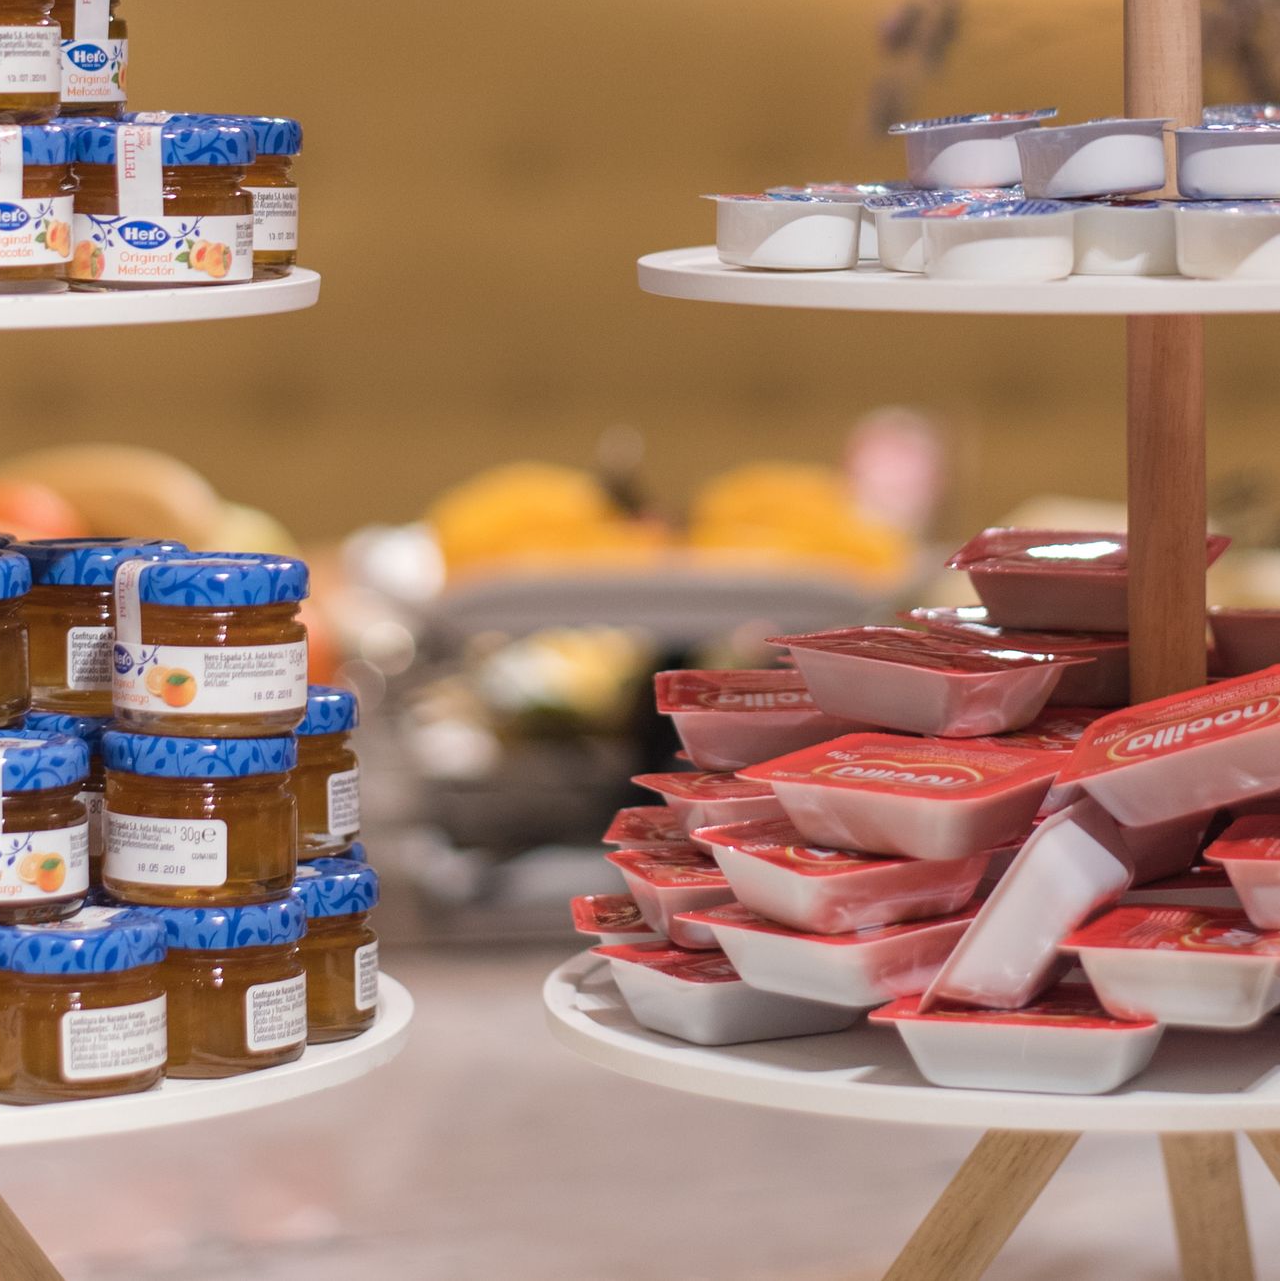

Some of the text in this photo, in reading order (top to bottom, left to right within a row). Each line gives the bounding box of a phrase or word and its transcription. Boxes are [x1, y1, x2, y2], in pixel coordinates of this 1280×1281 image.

[74, 51, 106, 63] Hero
[69, 73, 110, 84] Original
[67, 85, 111, 96] Melocotón
[125, 138, 136, 179] PETIT
[124, 227, 166, 241] Hero
[120, 251, 173, 265] Original
[118, 264, 175, 276] Melocotón
[1126, 701, 1270, 751] nocilla
[834, 765, 967, 787] nocilla
